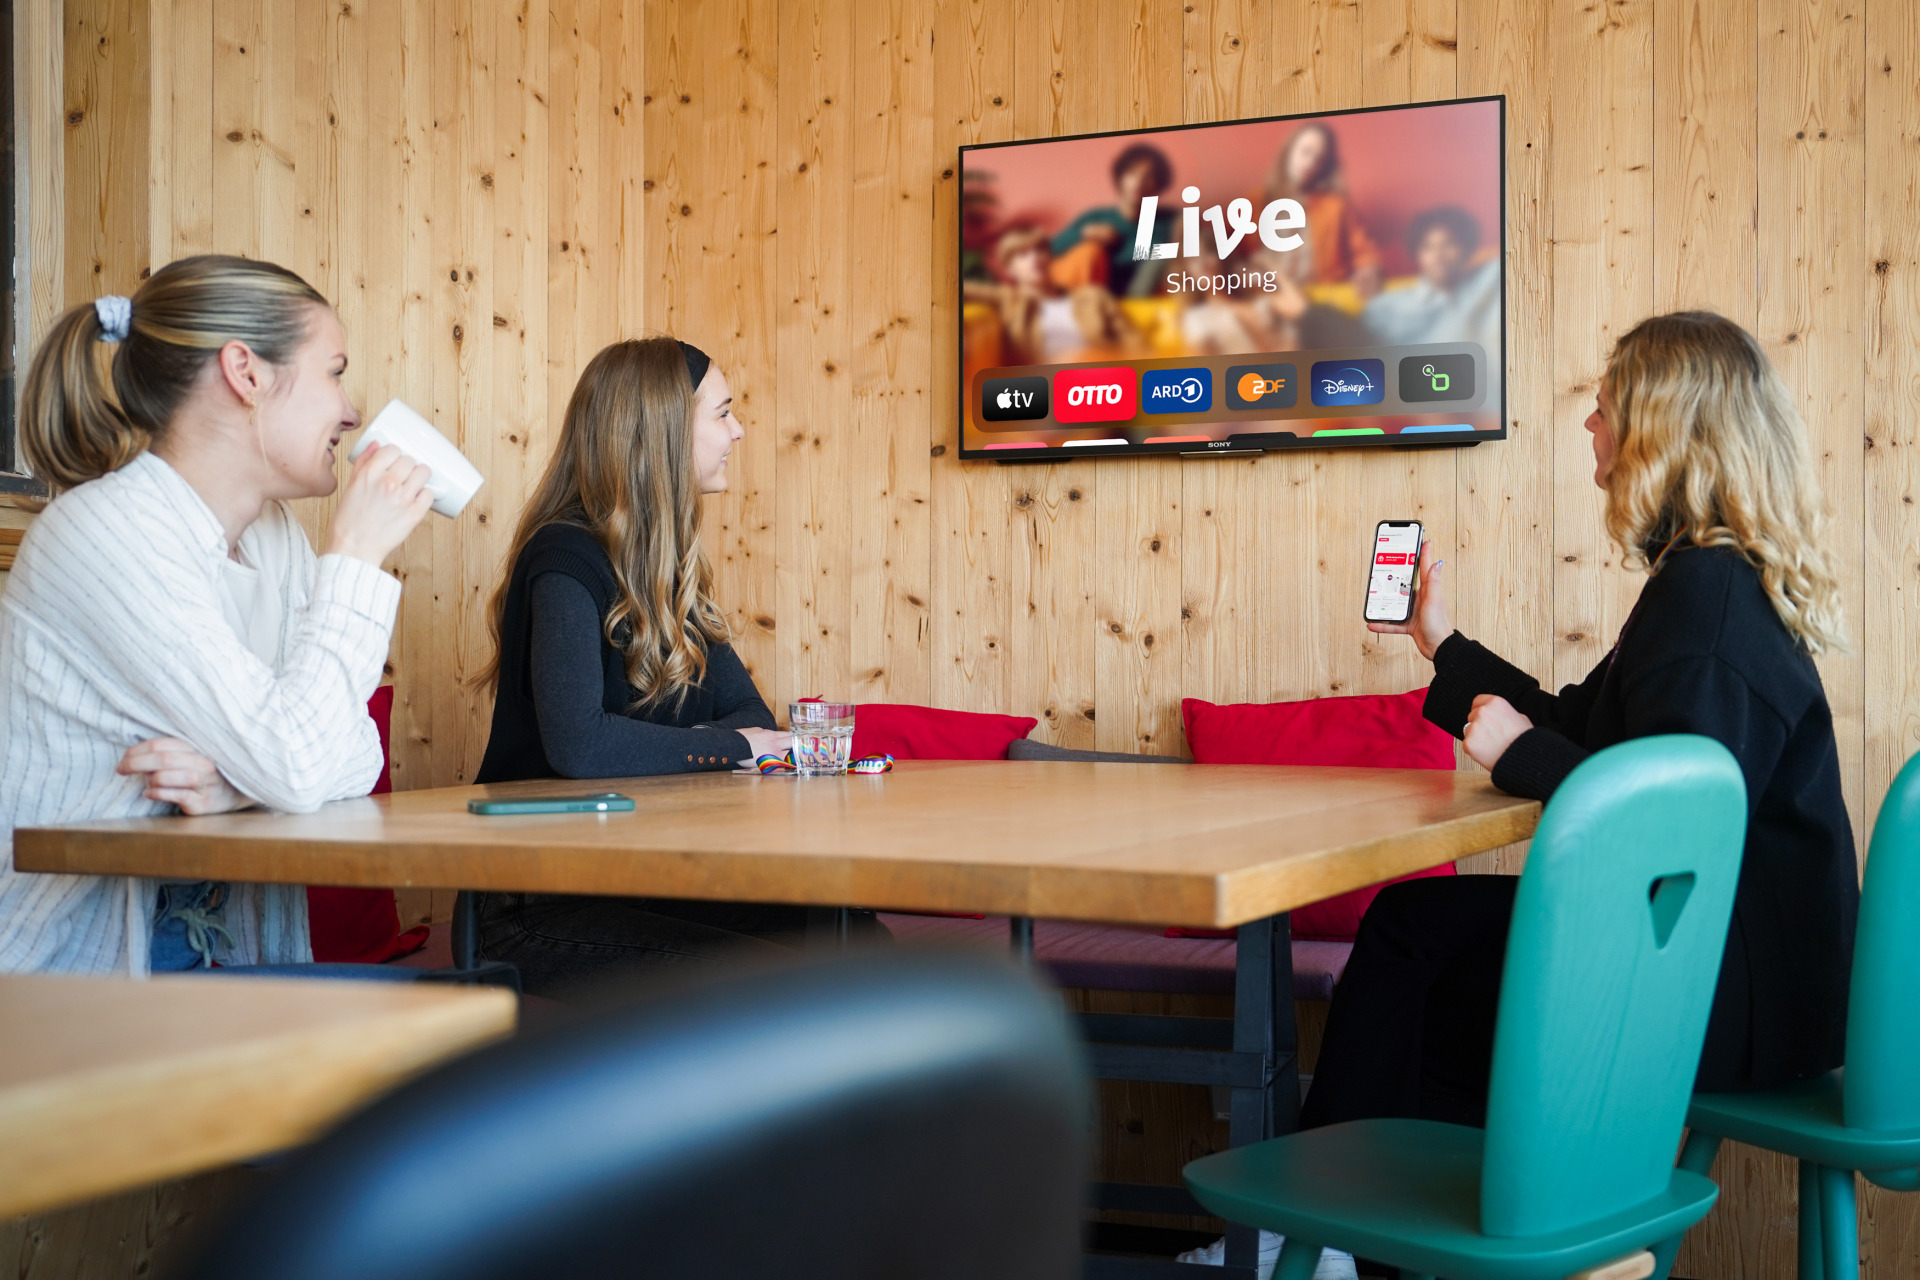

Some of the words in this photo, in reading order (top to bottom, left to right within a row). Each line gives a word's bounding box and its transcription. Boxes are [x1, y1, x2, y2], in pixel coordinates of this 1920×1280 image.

[1132, 186, 1306, 261] Live
[1166, 267, 1277, 295] Shopping
[1067, 384, 1122, 406] OTTO
[1253, 378, 1285, 394] ZDF
[1012, 392, 1034, 408] tv
